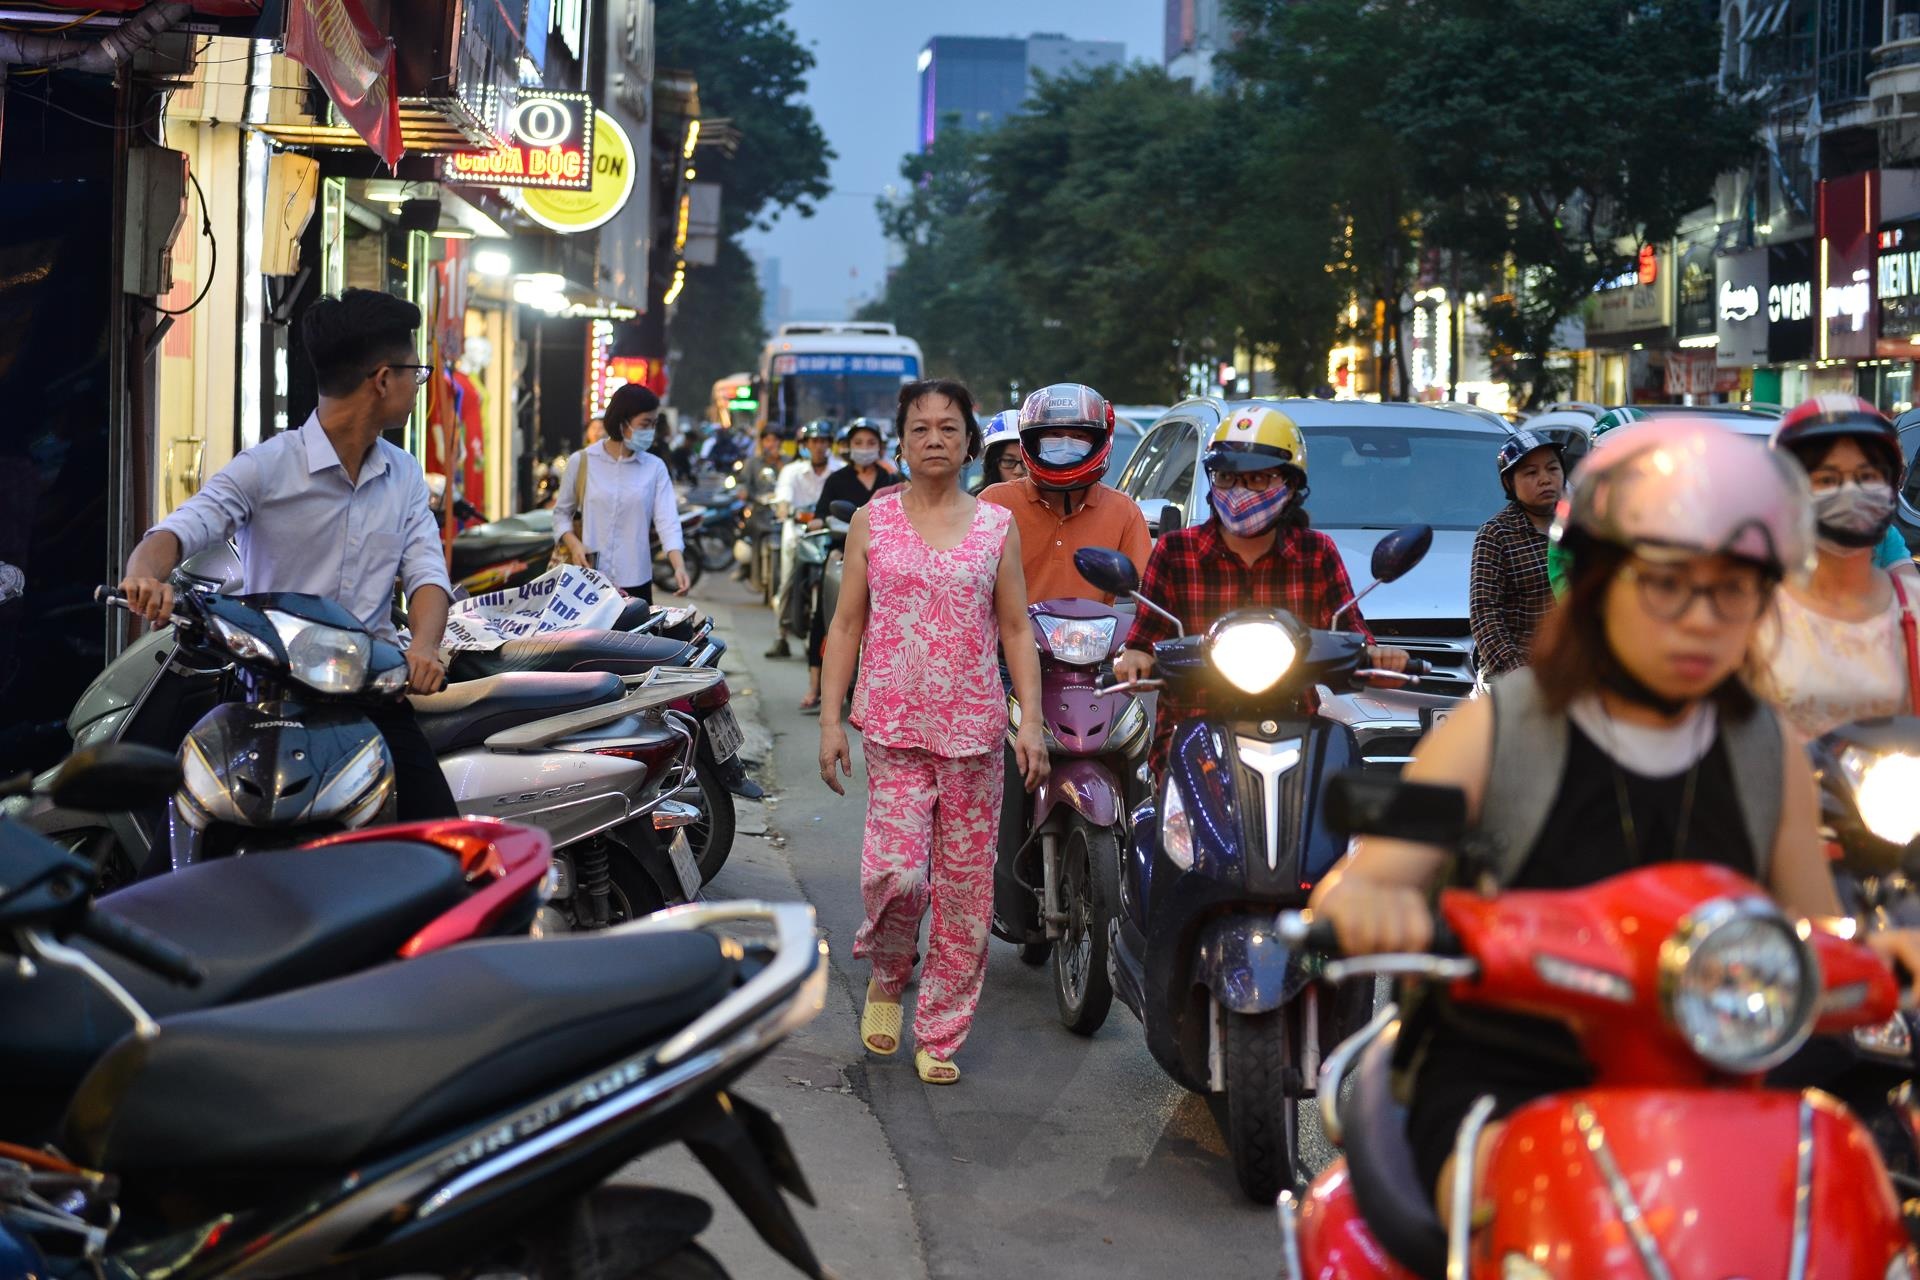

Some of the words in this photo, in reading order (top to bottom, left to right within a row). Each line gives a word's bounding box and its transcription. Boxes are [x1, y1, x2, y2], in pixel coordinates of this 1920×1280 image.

[594, 154, 624, 176] ON
[1048, 399, 1073, 408] INDEX
[253, 720, 305, 729] HONDA
